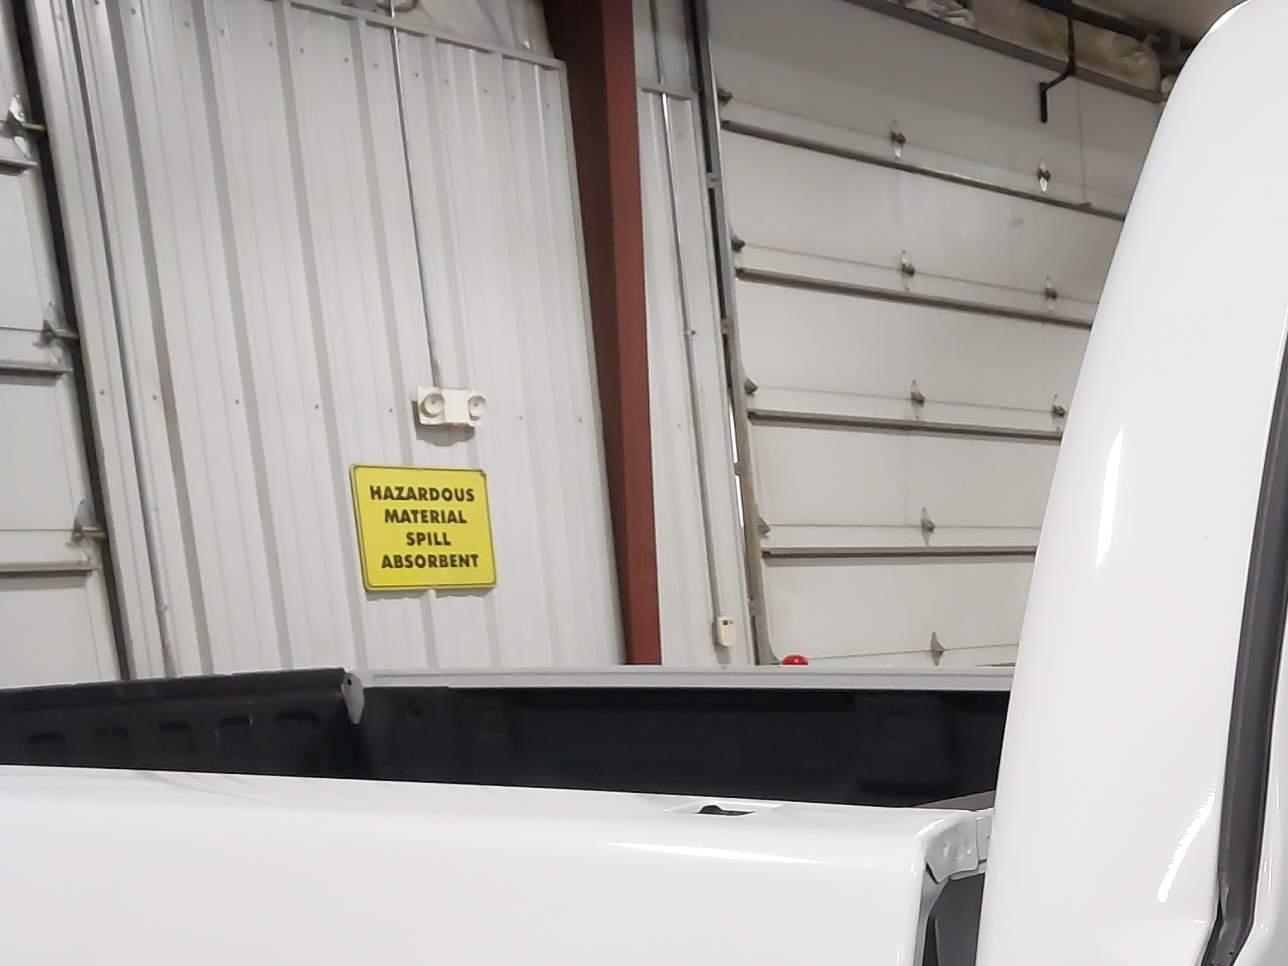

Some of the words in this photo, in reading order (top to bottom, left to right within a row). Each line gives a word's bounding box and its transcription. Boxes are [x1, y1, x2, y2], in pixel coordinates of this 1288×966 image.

[369, 485, 475, 502] HAZARDOUS
[384, 509, 467, 524] MATERIAL
[406, 532, 451, 546] SPILL
[381, 554, 479, 569] ABSORBENT
